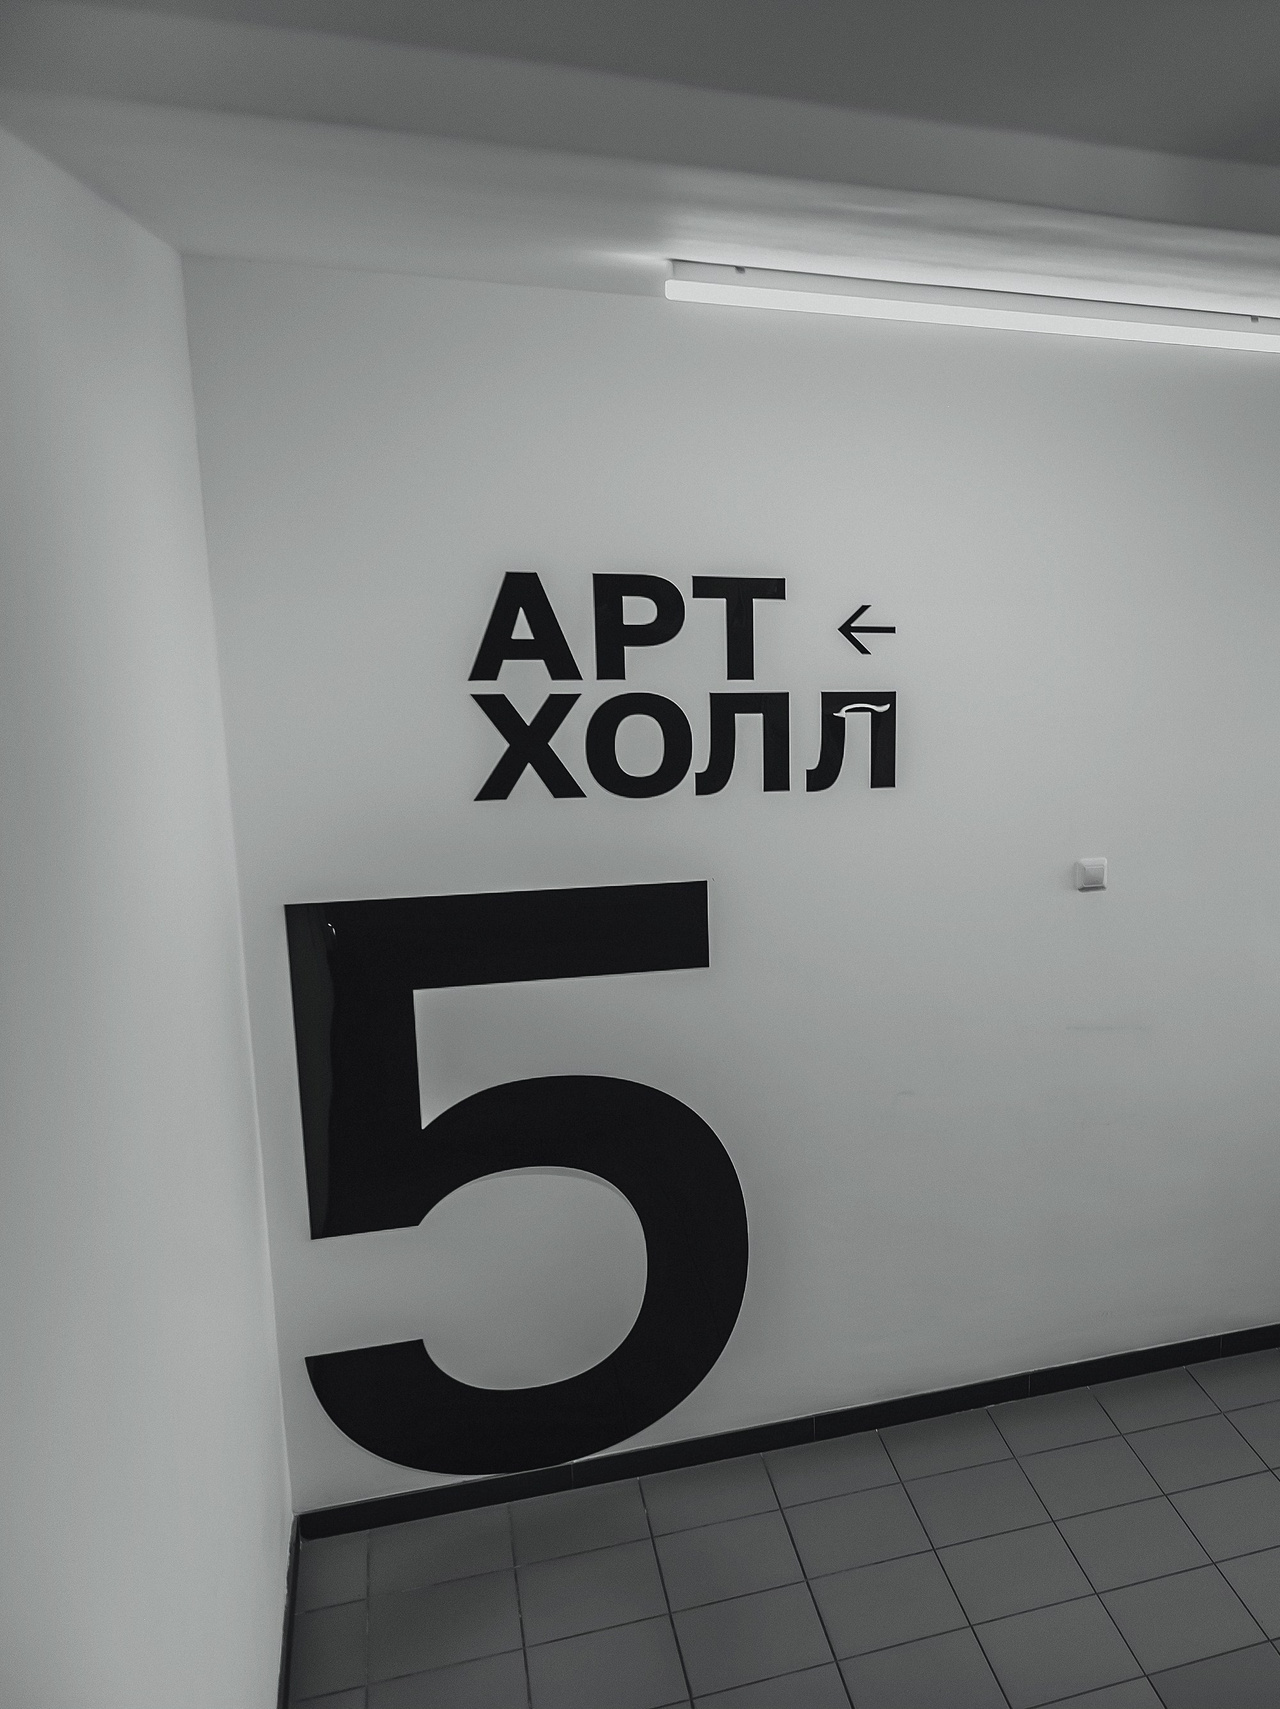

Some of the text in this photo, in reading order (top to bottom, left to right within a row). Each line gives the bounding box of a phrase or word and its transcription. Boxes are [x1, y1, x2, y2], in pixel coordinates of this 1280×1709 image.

[468, 571, 786, 681] АРТ
[470, 691, 897, 801] ХОЛЛ
[284, 880, 749, 1476] 5
